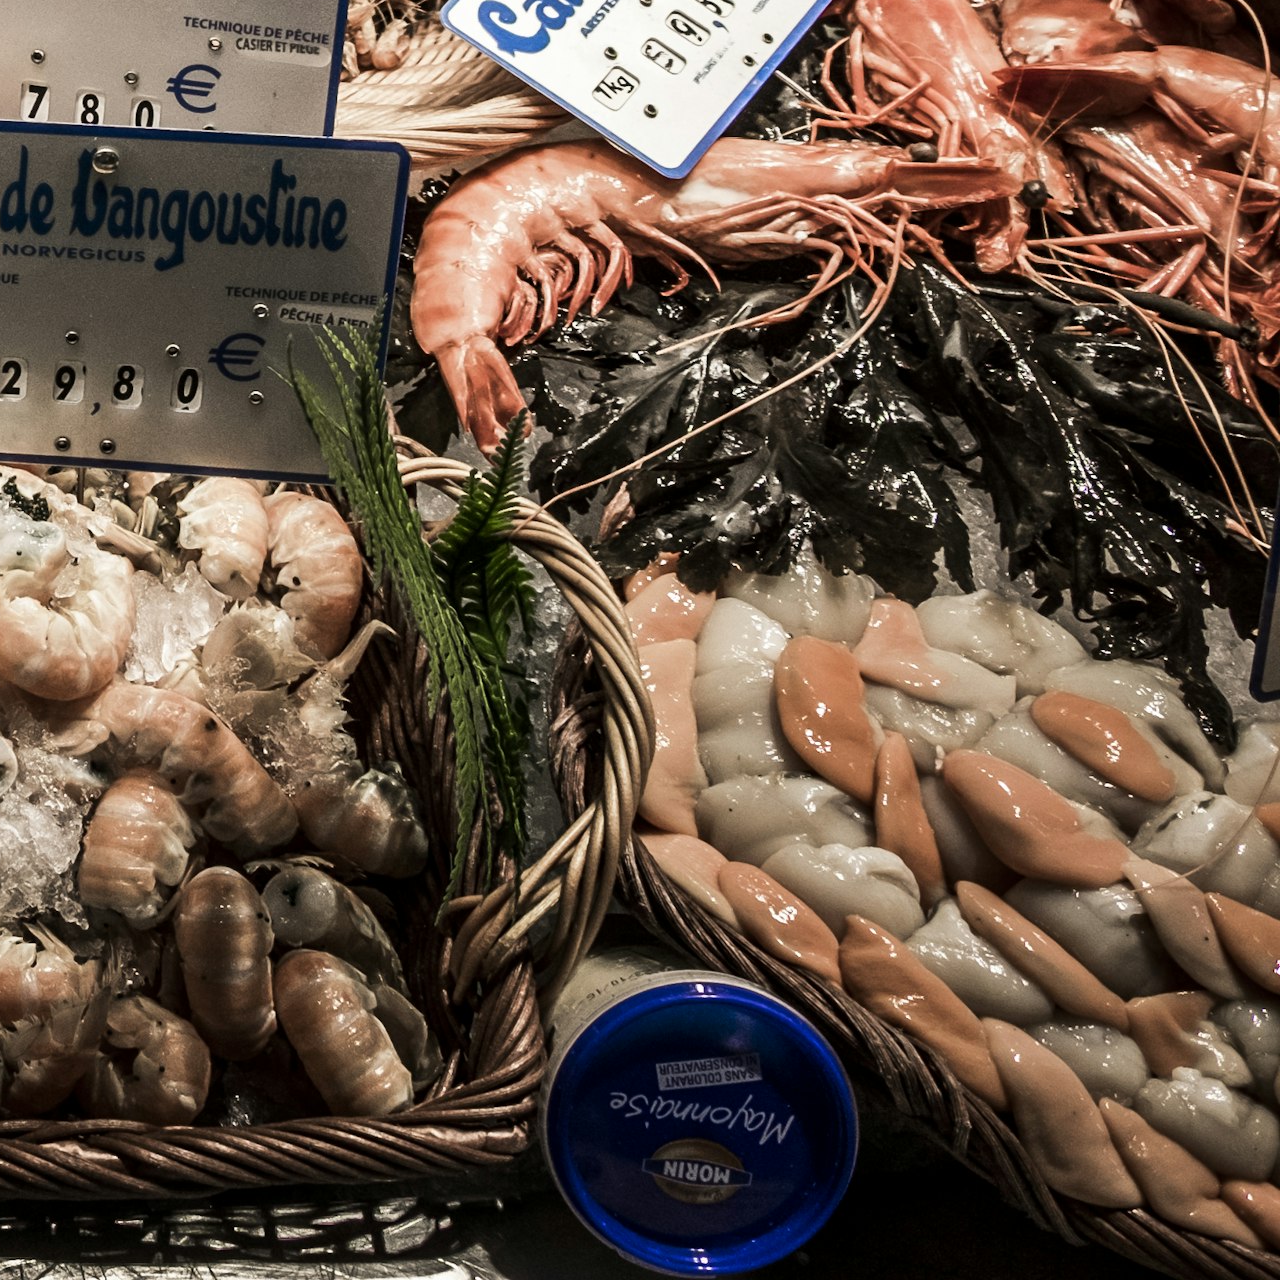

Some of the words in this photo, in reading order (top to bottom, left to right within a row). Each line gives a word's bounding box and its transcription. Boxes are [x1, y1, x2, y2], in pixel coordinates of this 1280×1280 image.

[184, 16, 260, 36] TECHNIQUE
[264, 27, 282, 39] DE
[285, 29, 330, 45] PÊCHE
[235, 38, 273, 52] CASIER
[275, 41, 287, 53] ET
[0, 144, 55, 237] de
[68, 147, 349, 273] Langoustine
[2, 243, 146, 263] NORVEGICUS
[226, 286, 306, 302] TECHNIQUE
[310, 291, 329, 303] DE
[332, 291, 378, 306] PÊCHE
[280, 307, 323, 325] PÊCHE
[323, 312, 334, 326] À
[658, 1056, 744, 1076] CONSERVATEUR
[725, 1067, 755, 1082] SANS
[664, 1070, 723, 1089] COLORANT
[609, 1091, 795, 1146] Mayonnaise
[662, 1160, 730, 1185] MORIN
